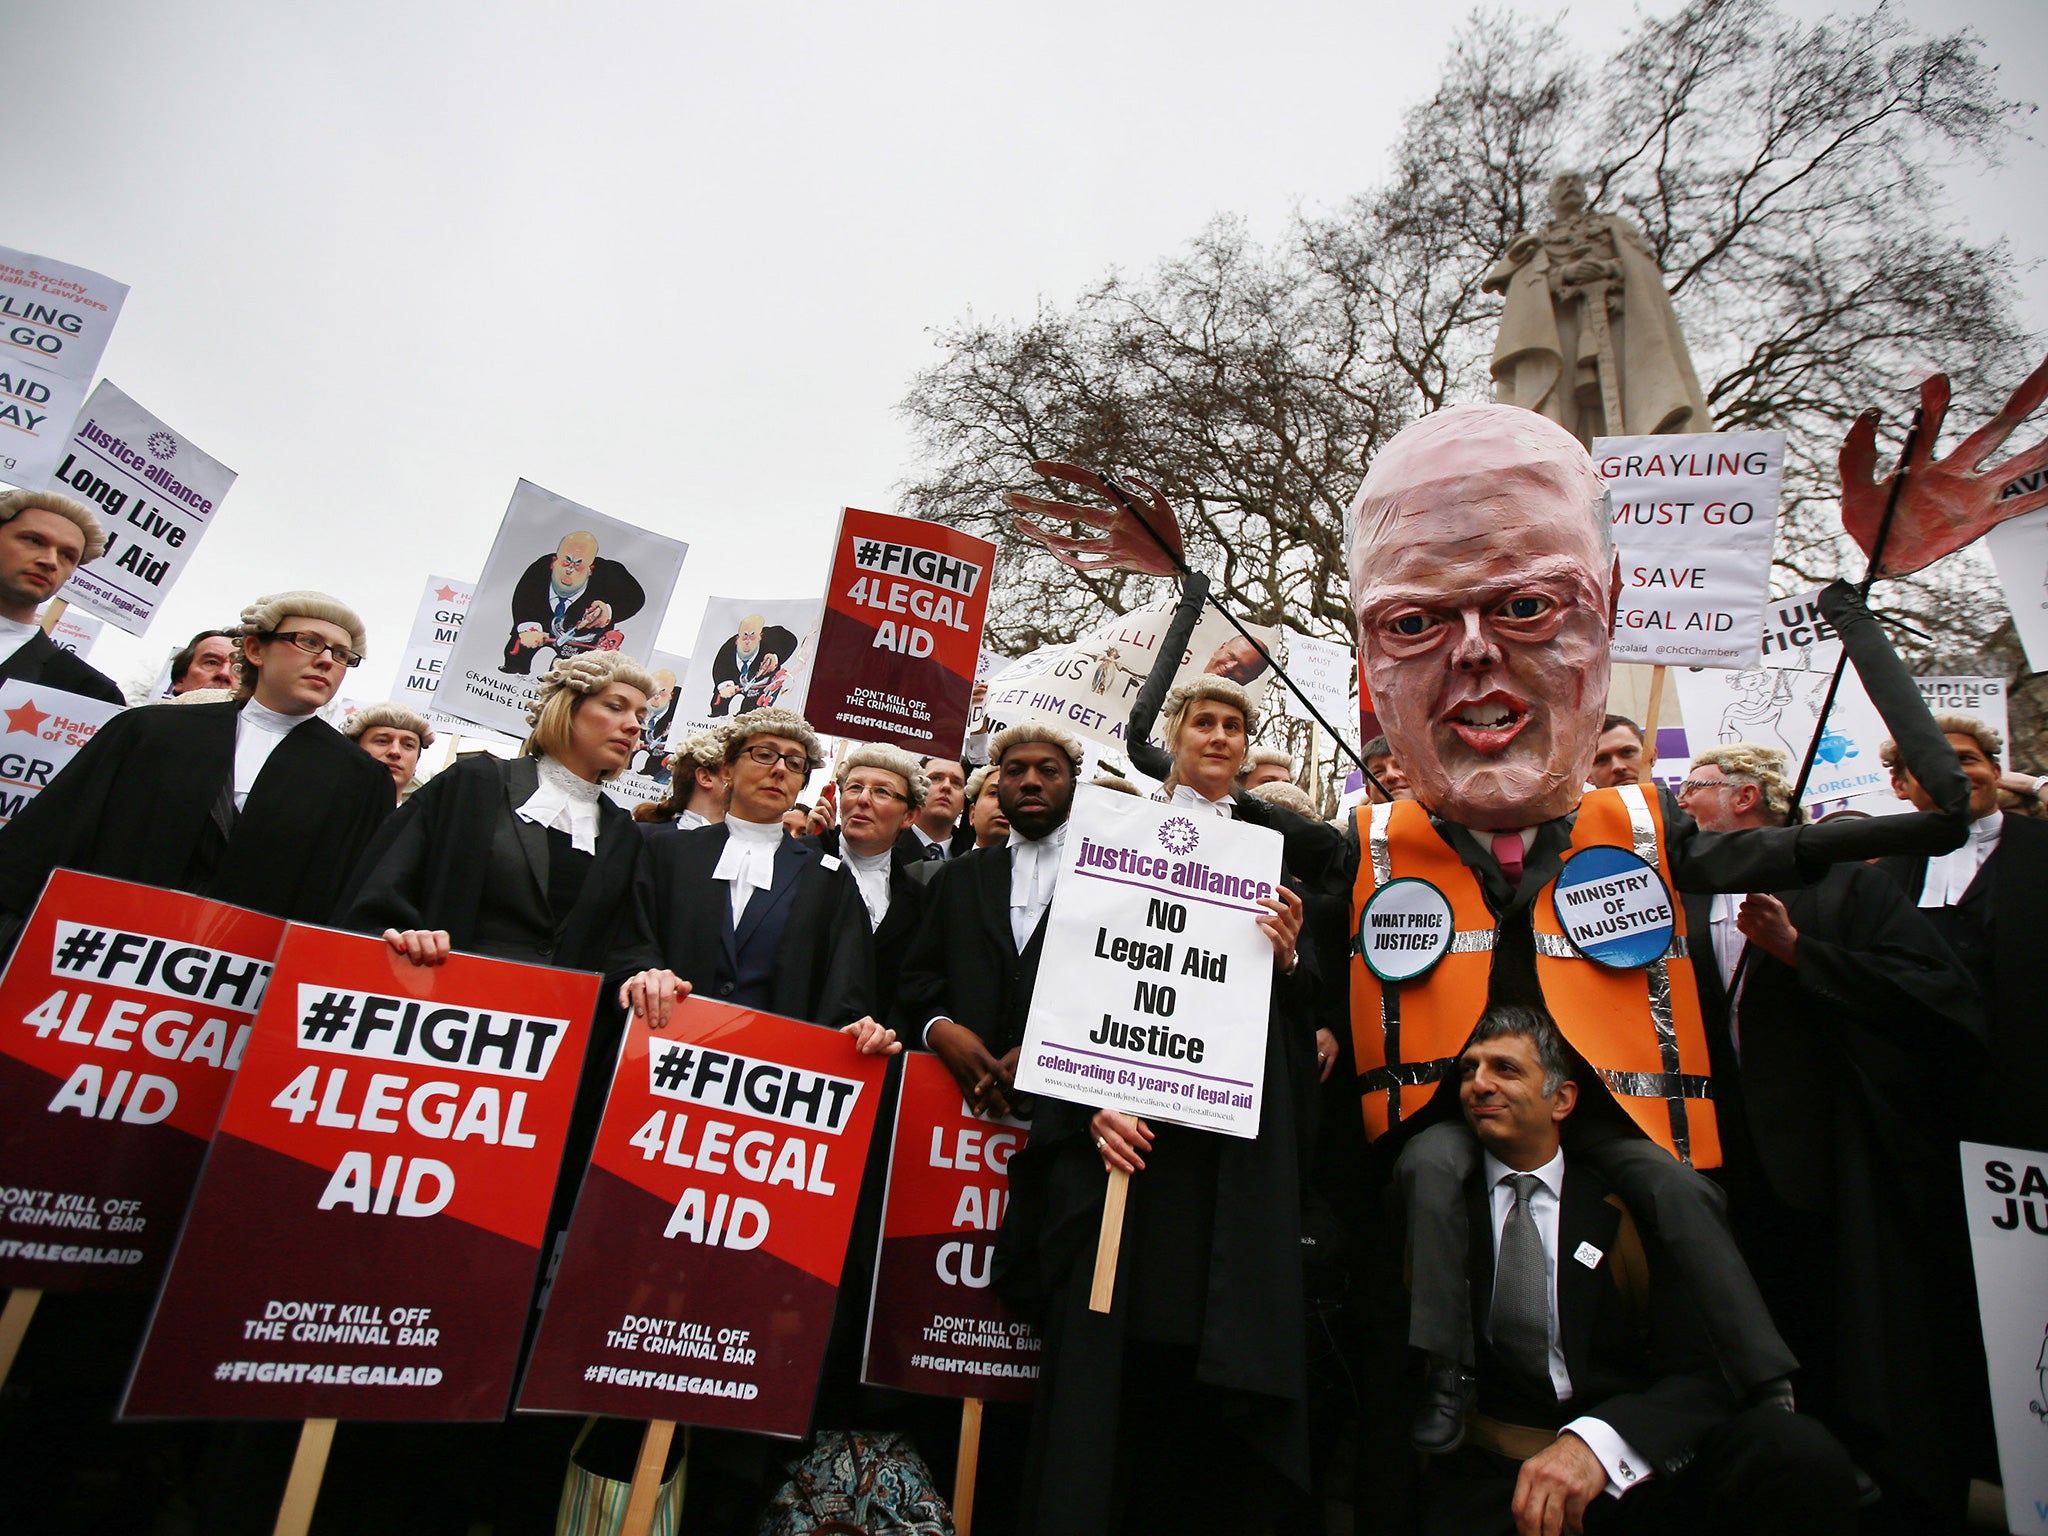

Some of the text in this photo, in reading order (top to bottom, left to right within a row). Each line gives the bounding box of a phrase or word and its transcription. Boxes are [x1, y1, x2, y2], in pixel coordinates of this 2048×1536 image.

[30, 270, 88, 294] Society
[41, 284, 109, 312] Lawyers
[10, 327, 63, 354] GO
[0, 403, 48, 431] AY
[78, 419, 213, 514] justice alliance
[1601, 452, 1767, 478] GRAYLING
[55, 453, 129, 516] Long
[126, 498, 187, 549] Live
[1703, 502, 1754, 525] GO
[115, 543, 171, 587] Aid
[856, 541, 977, 593] #FIGHT
[1632, 567, 1706, 589] SAVE
[71, 575, 102, 595] years
[101, 590, 113, 601] of
[112, 595, 135, 613] legal
[133, 607, 150, 619] aid
[847, 577, 970, 633] 4LEGAL
[1614, 609, 1733, 631] EGAL AID
[872, 620, 934, 659] AID
[1301, 642, 1340, 657] GRAYLING
[1610, 643, 1740, 658] legalaid @ChCtChambers
[1762, 620, 1839, 655] TICE
[1308, 656, 1331, 667] MUST
[1314, 669, 1326, 677] GO
[465, 670, 521, 697] GRAYLING,
[465, 684, 513, 708] FINALISE
[1296, 678, 1341, 695] SAVE LEGAL
[1918, 683, 2000, 696] NDING
[846, 695, 931, 722] THE CRIMINAL BAR
[854, 687, 926, 711] DON'T KILL OFF
[1030, 691, 1066, 714] HIM
[1068, 703, 1107, 730] GET
[1922, 696, 1980, 708] TICE
[42, 730, 62, 742] of
[53, 716, 100, 735] Hald
[835, 712, 933, 741] #FIGHT4LEGALAID
[623, 788, 646, 799] LEGAL
[1075, 837, 1272, 900] justice alliance
[1566, 874, 1650, 907] MINISTRY
[1146, 898, 1187, 933] NO
[1603, 898, 1626, 915] OF
[1371, 914, 1443, 928] WHAT PRICE
[1573, 905, 1671, 942] INJUSTICE
[1094, 927, 1228, 984] Legal Aid
[1374, 933, 1438, 950] JUSTICE?
[1133, 981, 1176, 1017] NO
[302, 992, 558, 1073] #FIGHT
[1089, 1014, 1205, 1064] Justice
[48, 1063, 178, 1125] AID
[653, 1045, 855, 1129] #FIGHT
[1037, 1053, 1253, 1110] celebrating 64 years of legal aid
[270, 1065, 536, 1149] 4LEGAL
[629, 1109, 836, 1196] 4LEGAL
[929, 1126, 1022, 1175] LEG
[317, 1150, 456, 1218] AID
[9, 1206, 101, 1230] CRIMINAL
[107, 1216, 147, 1232] BAR
[55, 1194, 97, 1213] KILL
[103, 1199, 142, 1216] OFF
[952, 1185, 1010, 1231] AI
[663, 1188, 770, 1251] AID
[264, 1301, 431, 1326] DON'T KILL OFF
[933, 1315, 975, 1333] DON'T
[978, 1319, 1005, 1335] KILL
[244, 1321, 440, 1347] THE CRIMINAL BAR
[622, 1314, 749, 1346] DON'T KILL OFF
[923, 1327, 1042, 1351] THE CRIMINAL BAR
[606, 1330, 757, 1366] THE CRIMINAL BAR
[214, 1361, 443, 1387] #FIGHT4LEGALAID
[584, 1364, 759, 1400] #FIGHT4LEGALAID
